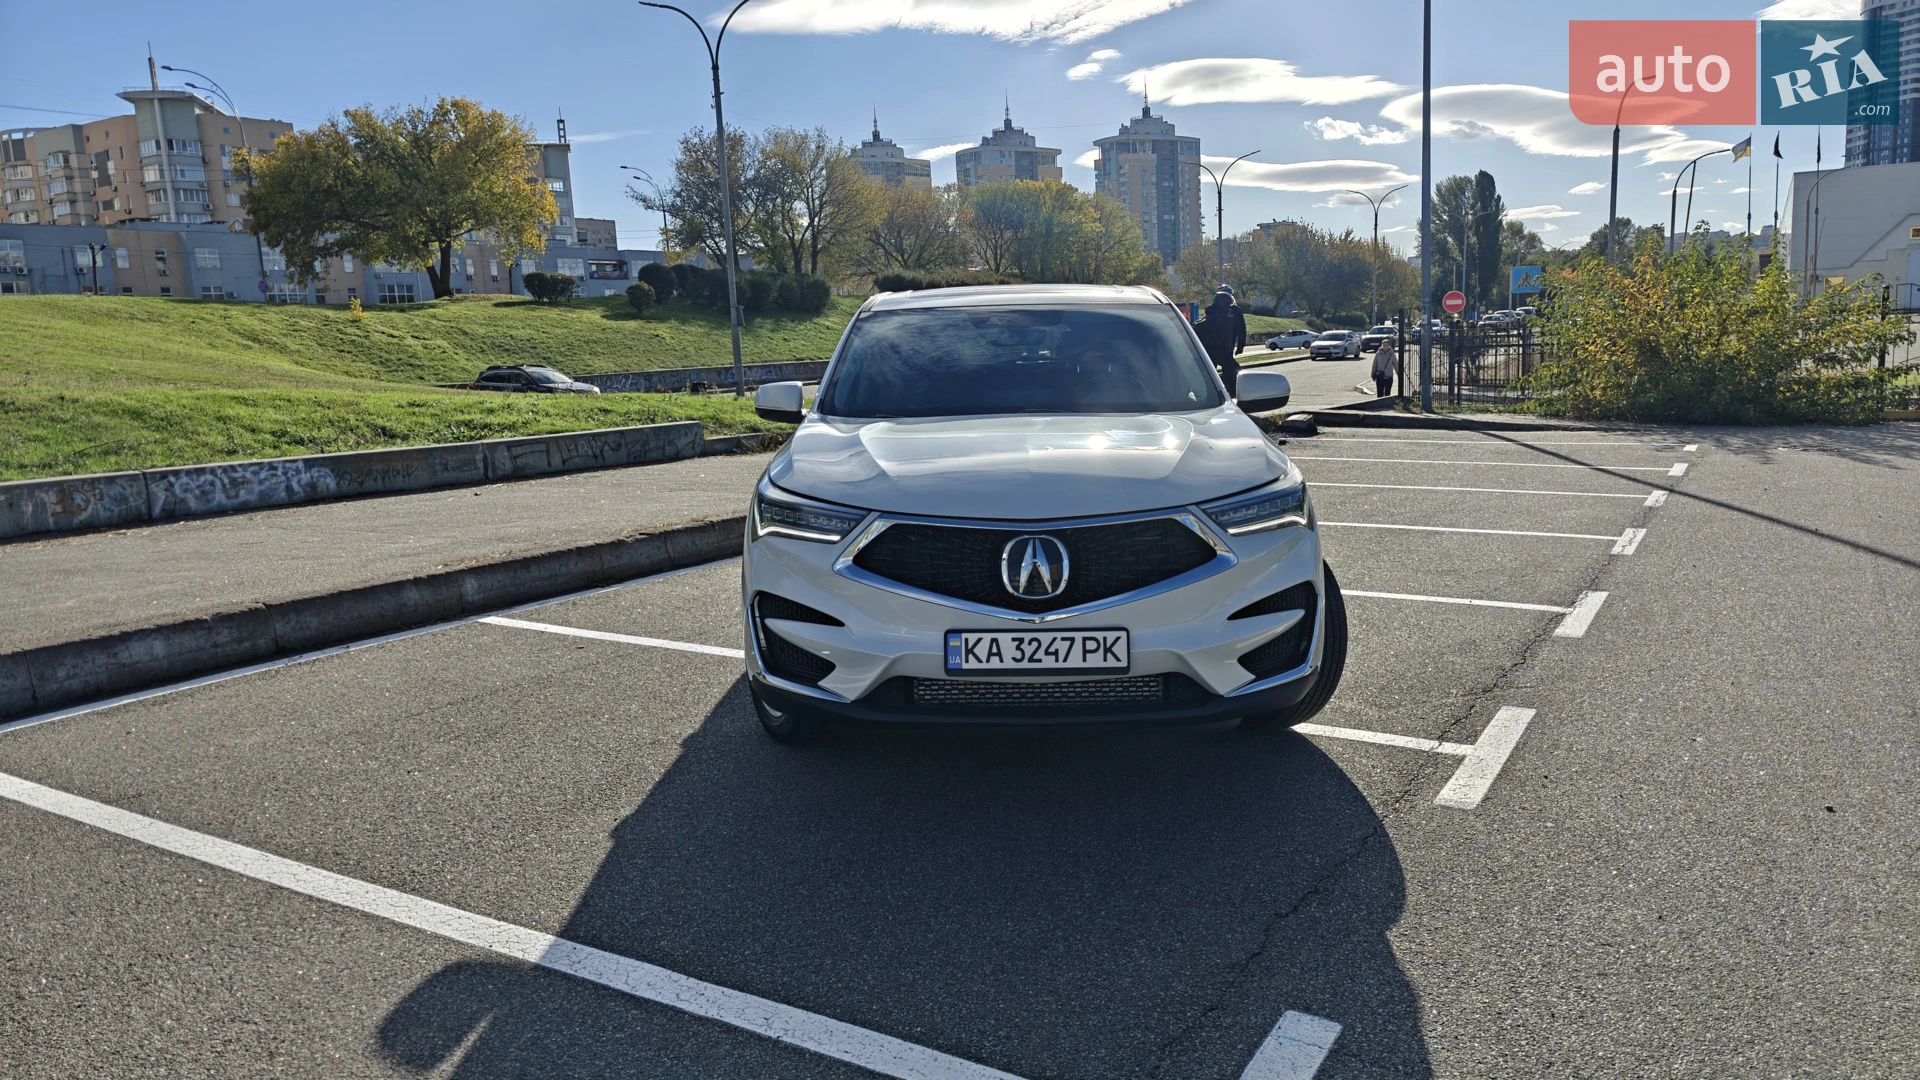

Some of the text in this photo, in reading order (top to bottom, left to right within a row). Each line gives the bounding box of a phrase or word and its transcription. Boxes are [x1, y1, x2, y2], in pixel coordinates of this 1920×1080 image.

[964, 636, 1122, 664] KA 3247 PK
[949, 656, 961, 664] UA
